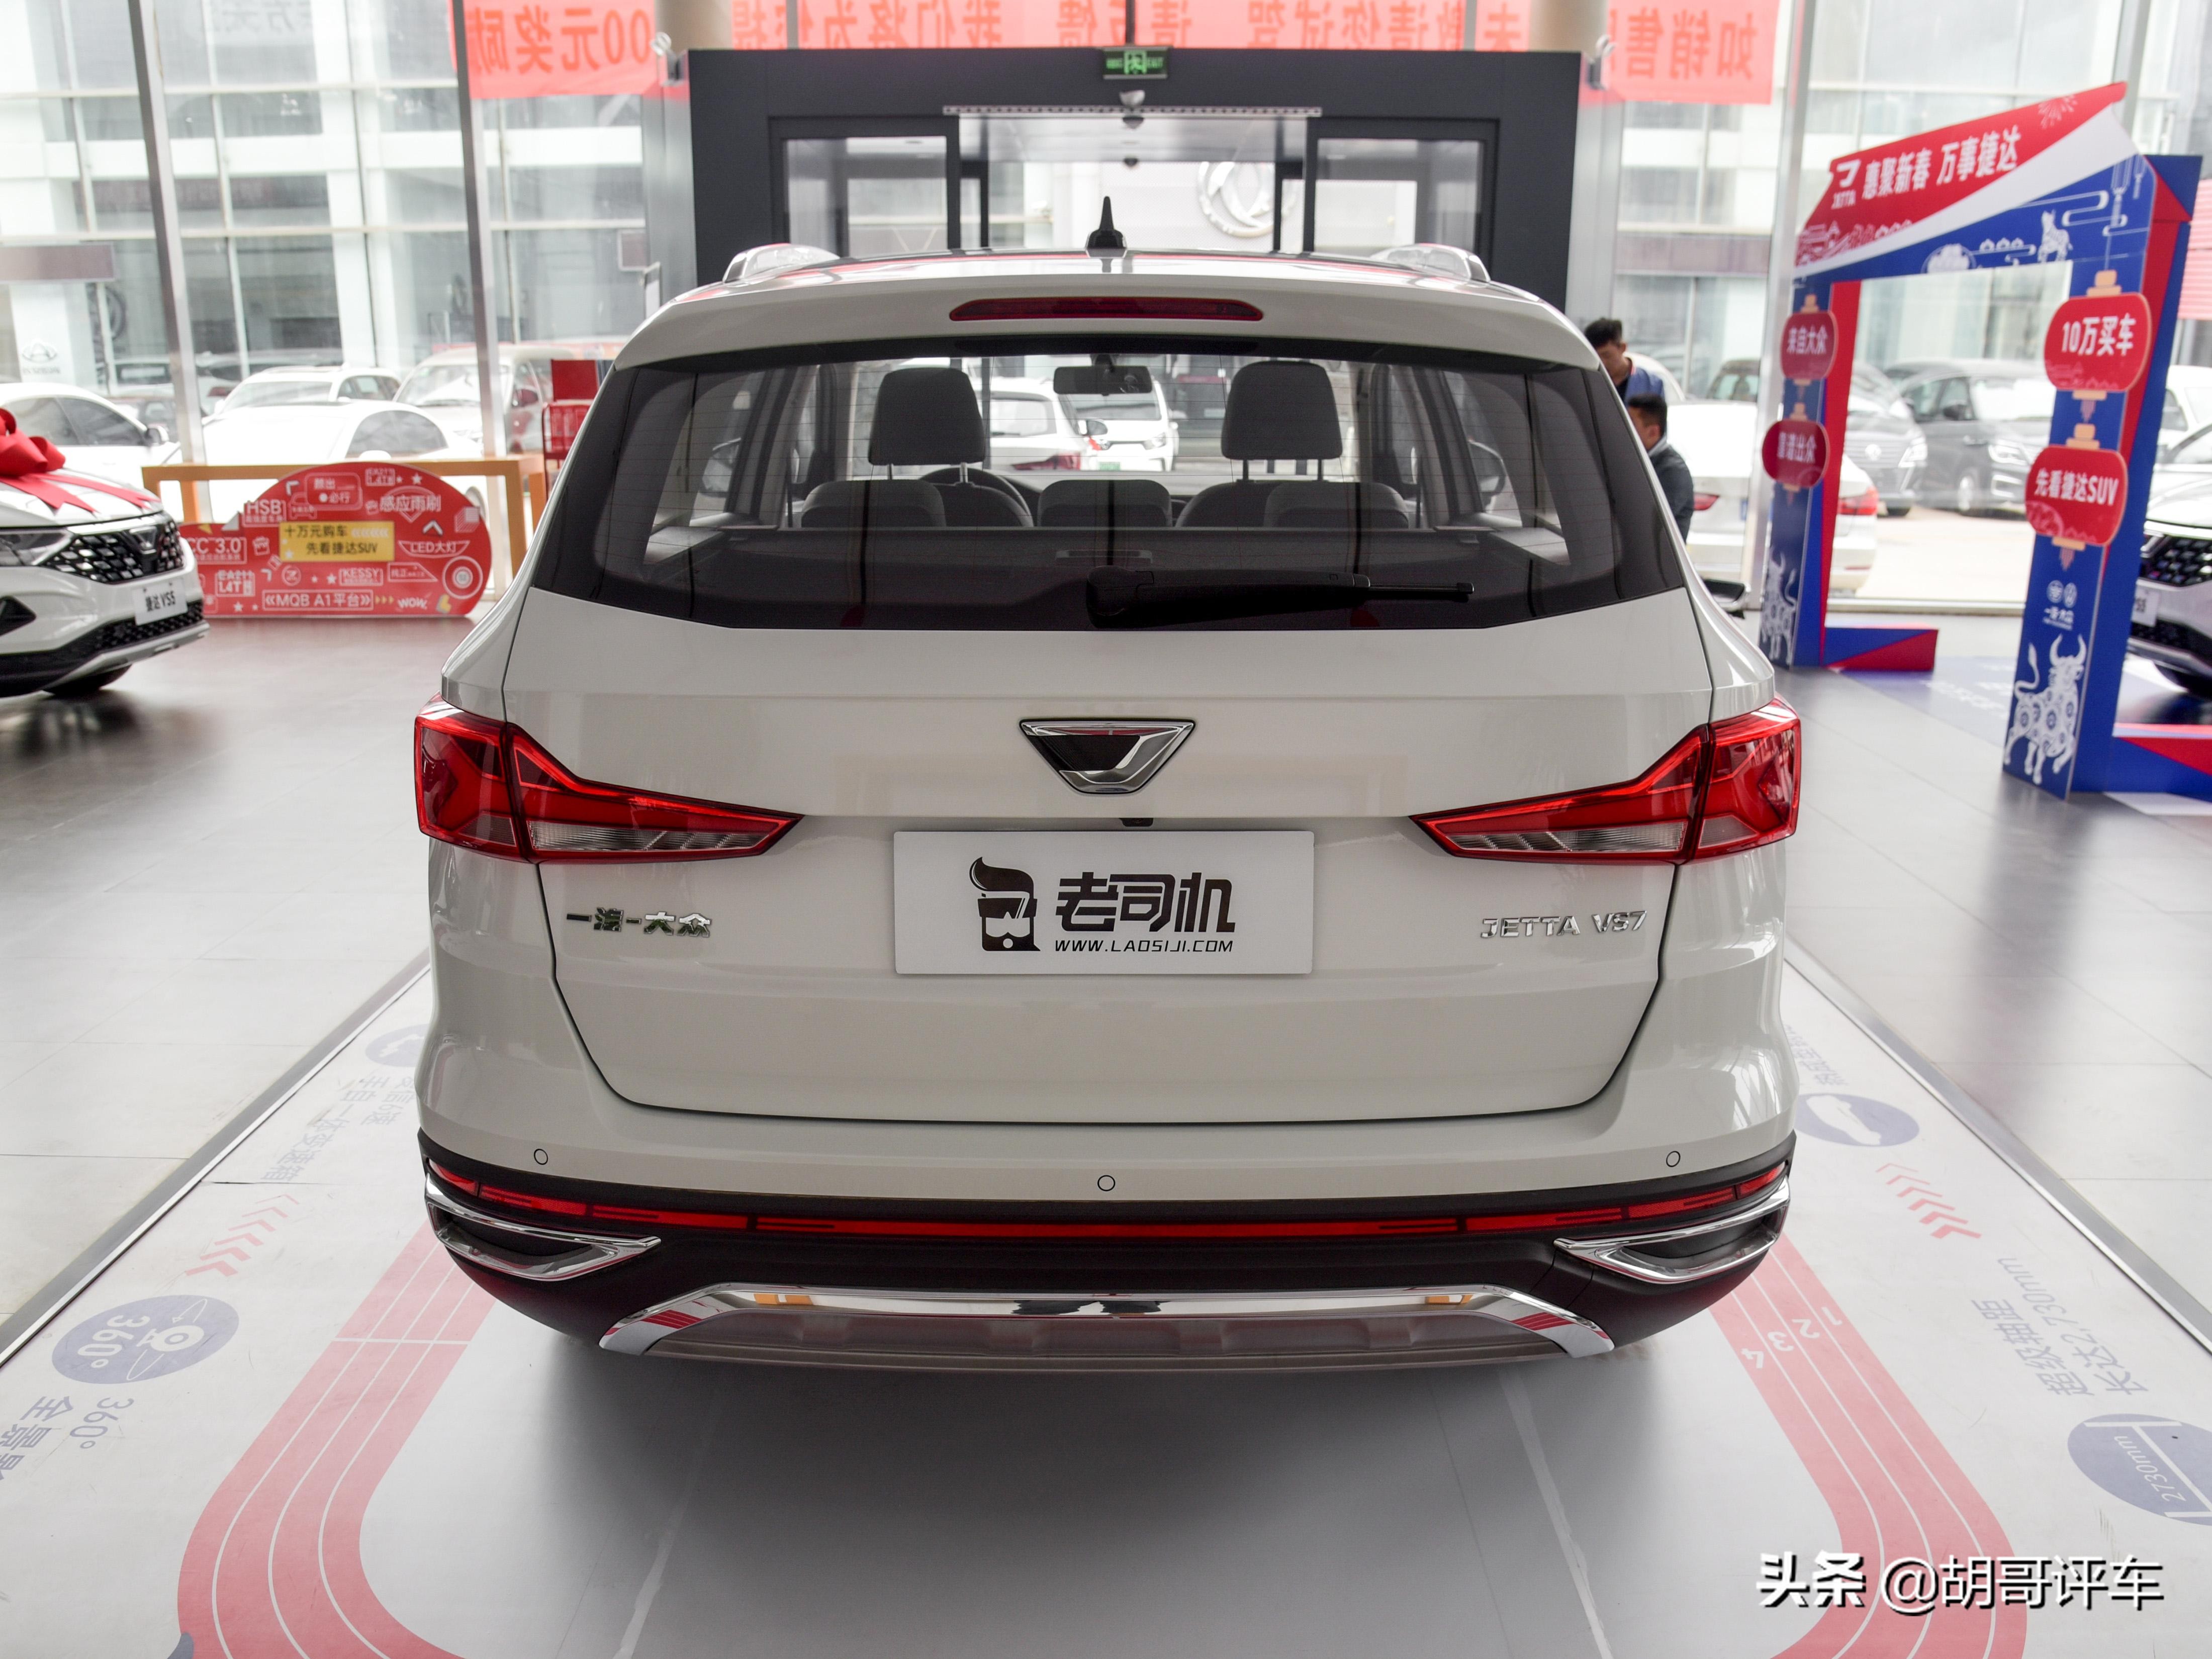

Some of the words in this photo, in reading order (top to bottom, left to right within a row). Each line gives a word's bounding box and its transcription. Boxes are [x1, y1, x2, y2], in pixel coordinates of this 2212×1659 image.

[2061, 313, 2137, 357] 10万买车
[2034, 468, 2119, 507] 先看捷达SUV
[247, 499, 283, 515] HSB
[380, 495, 441, 513] 感应雨刷
[285, 524, 348, 538] 十万元购车
[215, 537, 242, 554] 3.0
[306, 541, 378, 554] 先看捷达SUV
[409, 540, 456, 554] LED大灯
[1055, 871, 1236, 933] 老司机
[566, 907, 712, 938] 一汽-大众
[1480, 915, 1581, 939] JETTA
[1591, 910, 1647, 934] VS7
[1055, 940, 1233, 952] WWW.LAOSIJI.COM
[260, 1076, 390, 1180] 手自一体变速箱
[1820, 1306, 1843, 1326] 1
[1791, 1318, 1820, 1339] 2
[77, 1315, 150, 1368] 360°
[1767, 1331, 1794, 1351] 3
[1970, 1299, 2095, 1397] 超级轴距
[1741, 1347, 1765, 1368] 4
[69, 1397, 135, 1449] 360°
[2112, 1435, 2187, 1503] 2730mm
